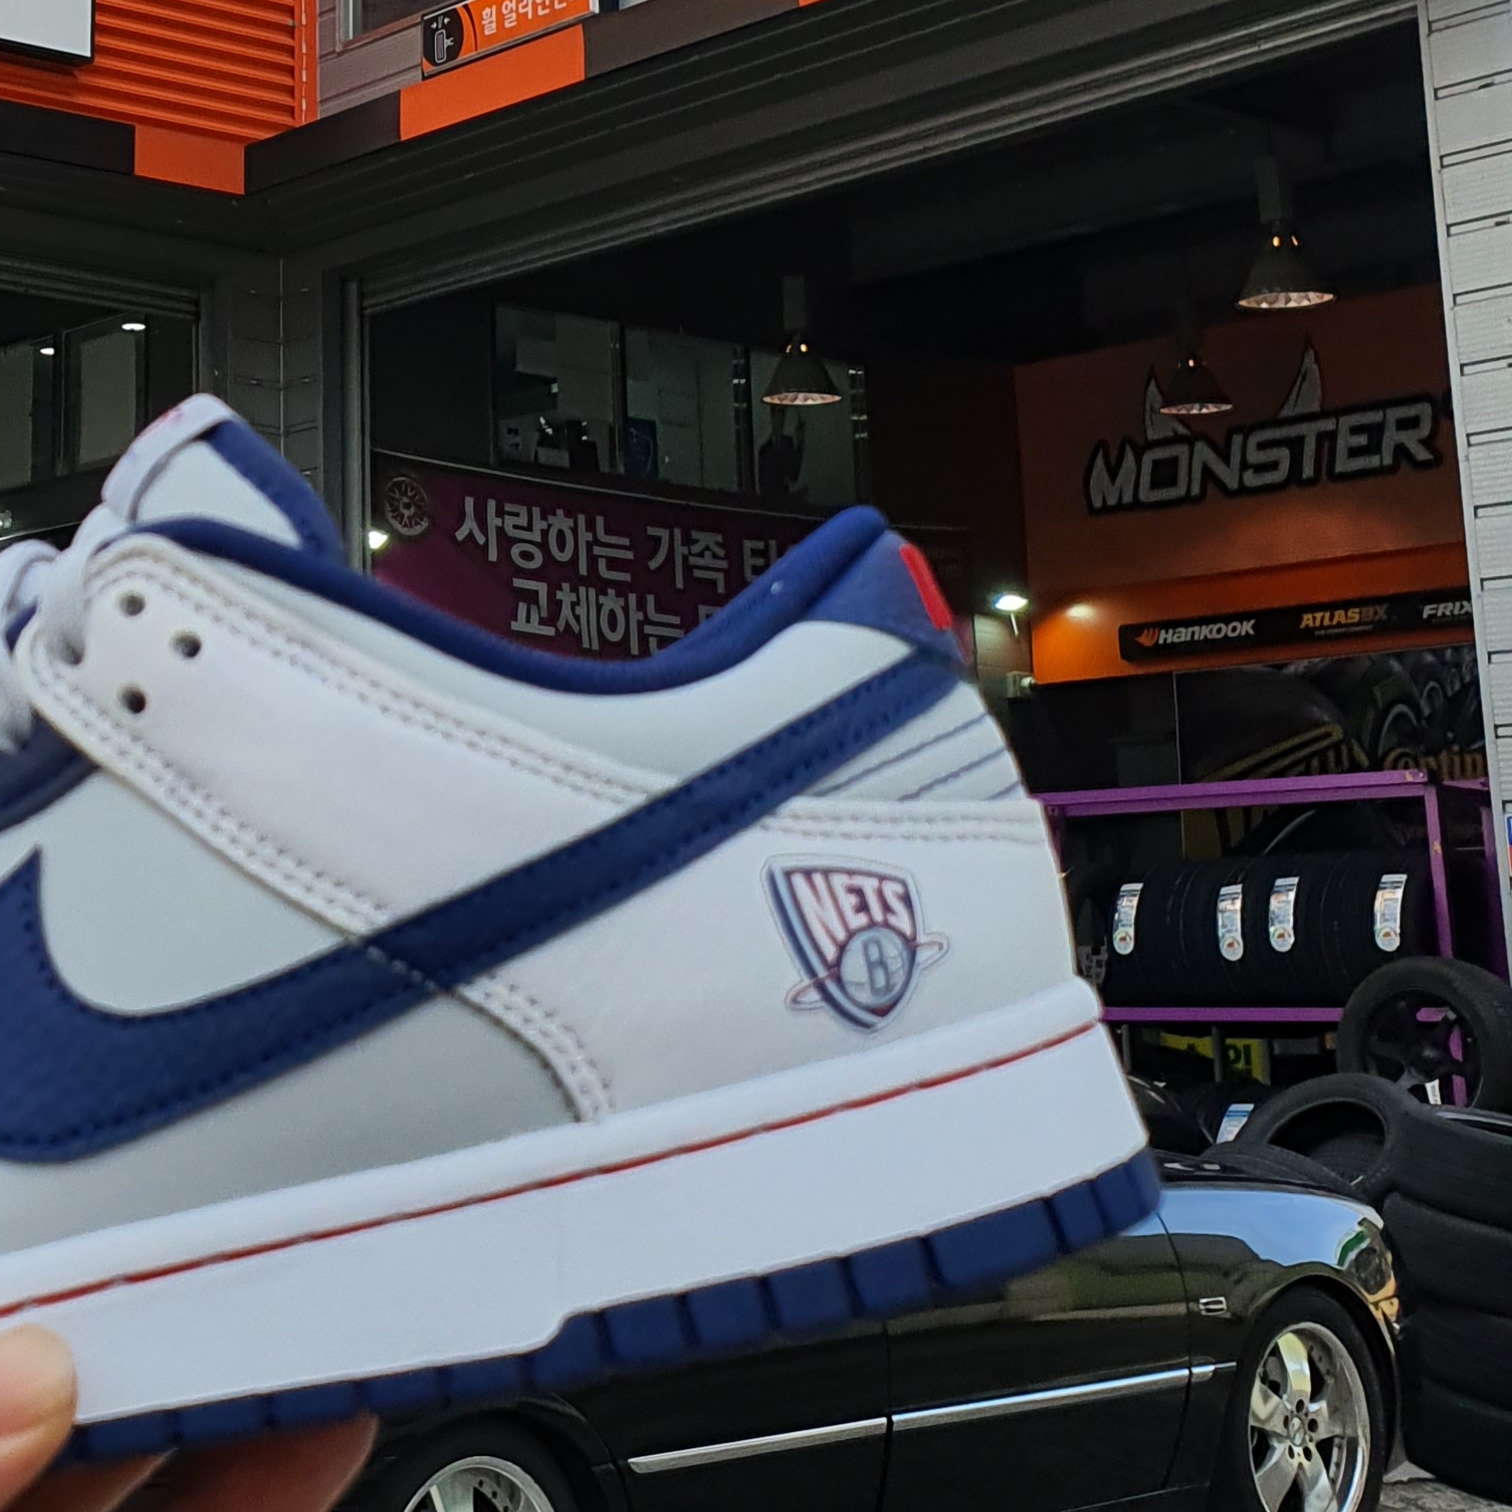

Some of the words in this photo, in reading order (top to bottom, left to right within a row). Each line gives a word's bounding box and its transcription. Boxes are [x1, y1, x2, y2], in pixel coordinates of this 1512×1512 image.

[481, 4, 498, 36] 휠
[1088, 400, 1435, 510] MONSTER
[454, 495, 635, 583] 사랑하는
[646, 524, 729, 594] 가족
[510, 577, 687, 656] 교체하는
[789, 870, 914, 966] NETS
